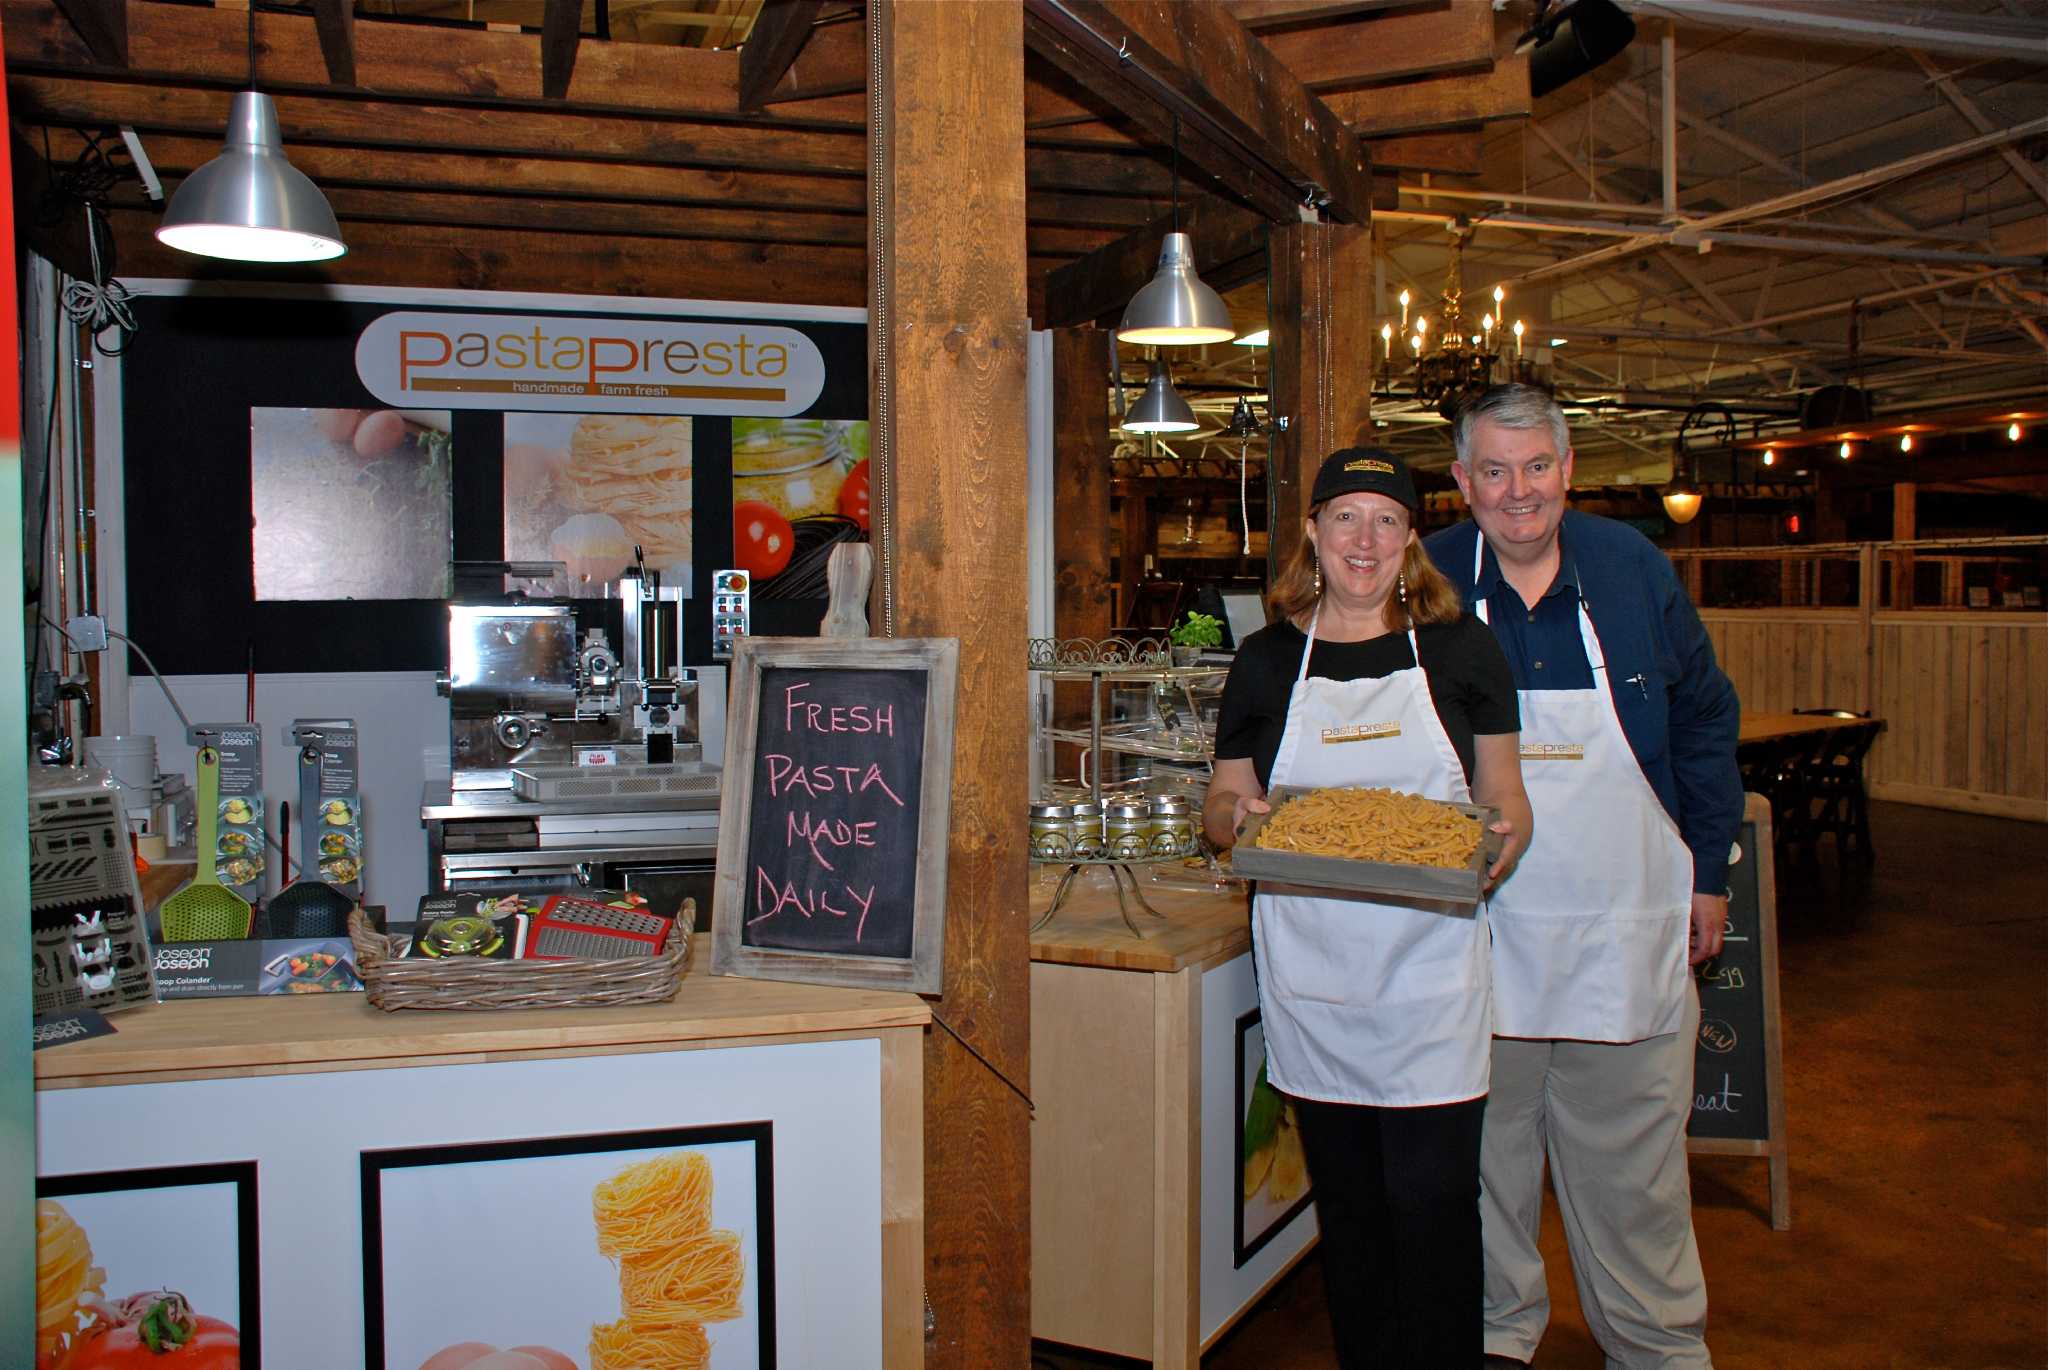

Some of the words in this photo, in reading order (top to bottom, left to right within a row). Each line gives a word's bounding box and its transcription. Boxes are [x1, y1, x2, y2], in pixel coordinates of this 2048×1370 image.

[399, 325, 789, 392] pastapresta
[512, 381, 585, 394] handmade
[600, 383, 632, 395] farm
[635, 385, 669, 396] fresh
[785, 682, 894, 737] FRESH
[1519, 743, 1584, 758] astapresta
[764, 753, 905, 806] PASTA
[787, 811, 877, 871] MADE
[746, 865, 876, 943] DAILY
[153, 957, 209, 970] Joseph
[176, 977, 210, 985] Colander
[1694, 1071, 1743, 1113] eat
